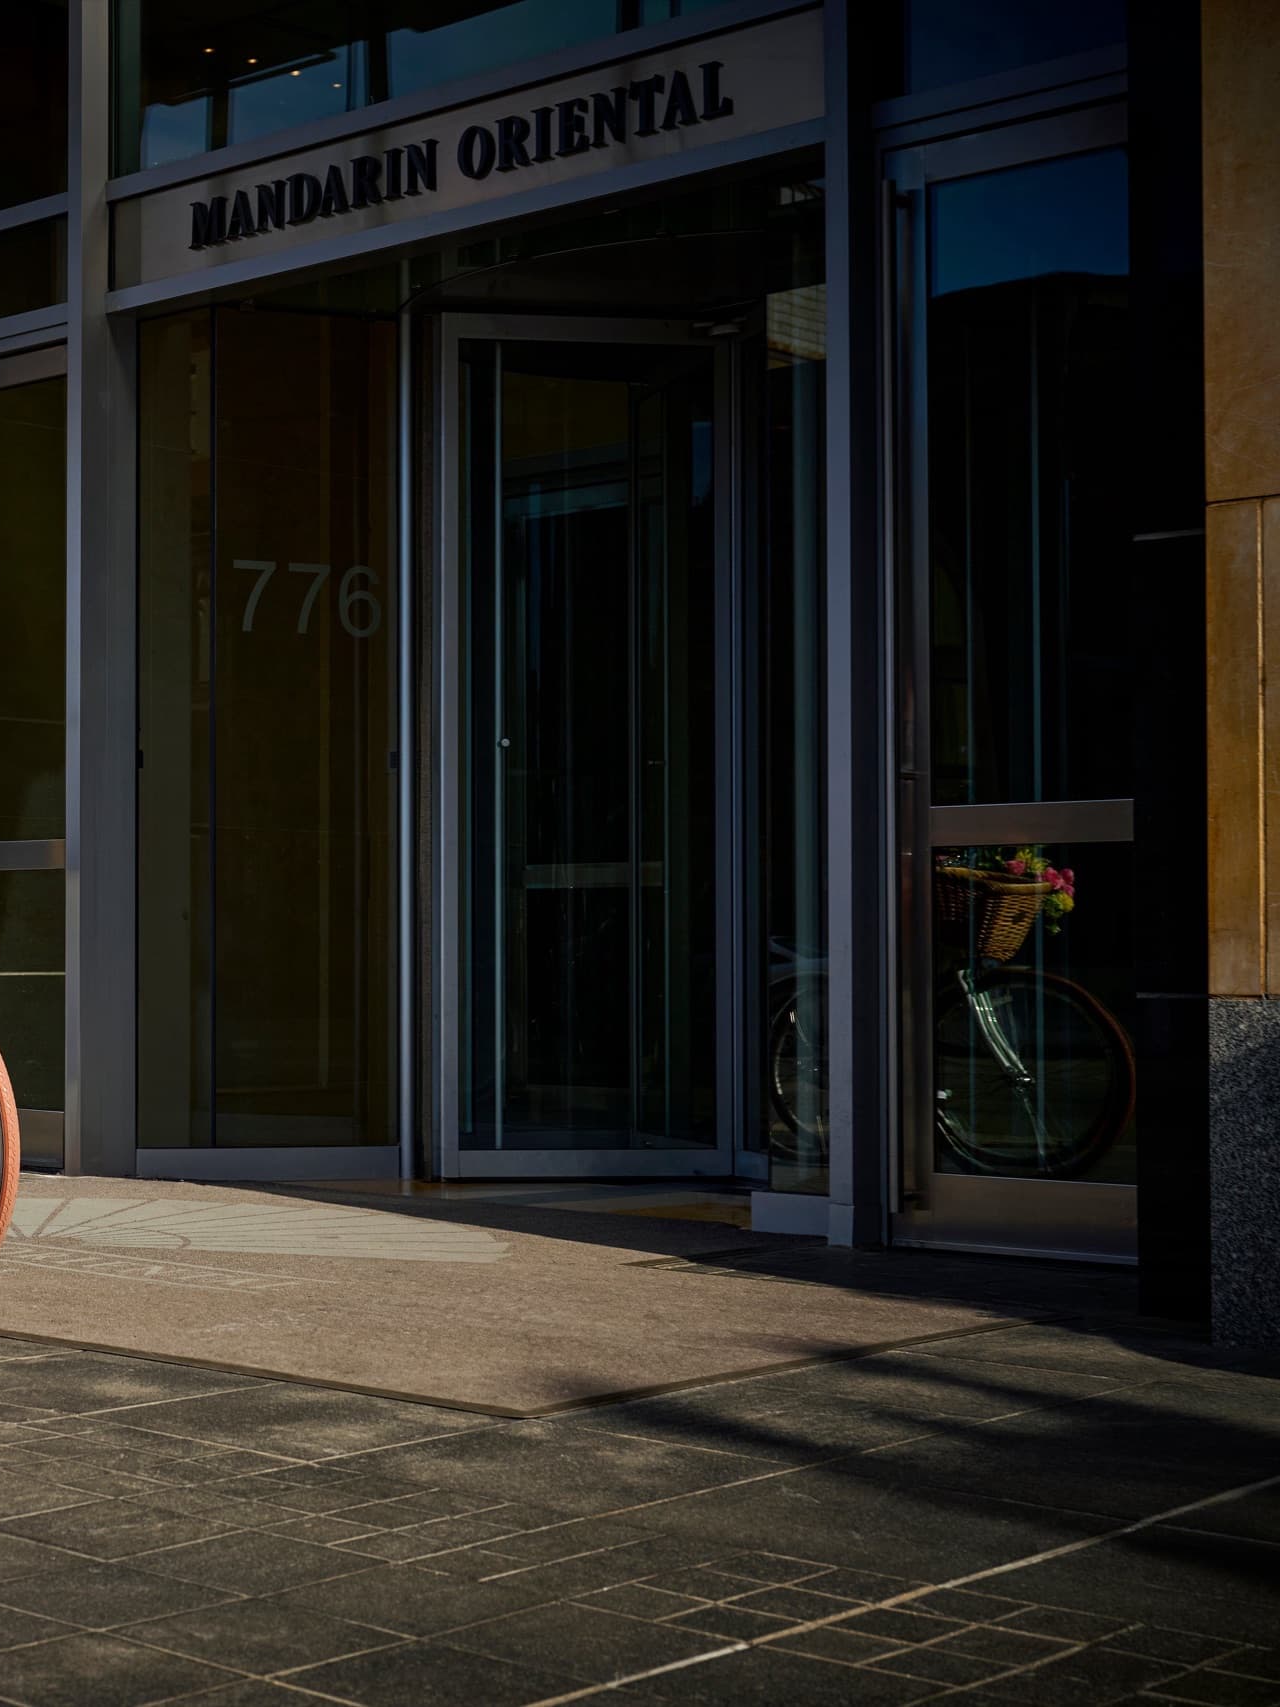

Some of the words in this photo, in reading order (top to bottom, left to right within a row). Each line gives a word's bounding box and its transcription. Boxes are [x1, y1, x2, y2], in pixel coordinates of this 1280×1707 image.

[189, 137, 439, 249] MANDARIN
[457, 60, 734, 180] ORIENTAL
[233, 559, 382, 638] 776
